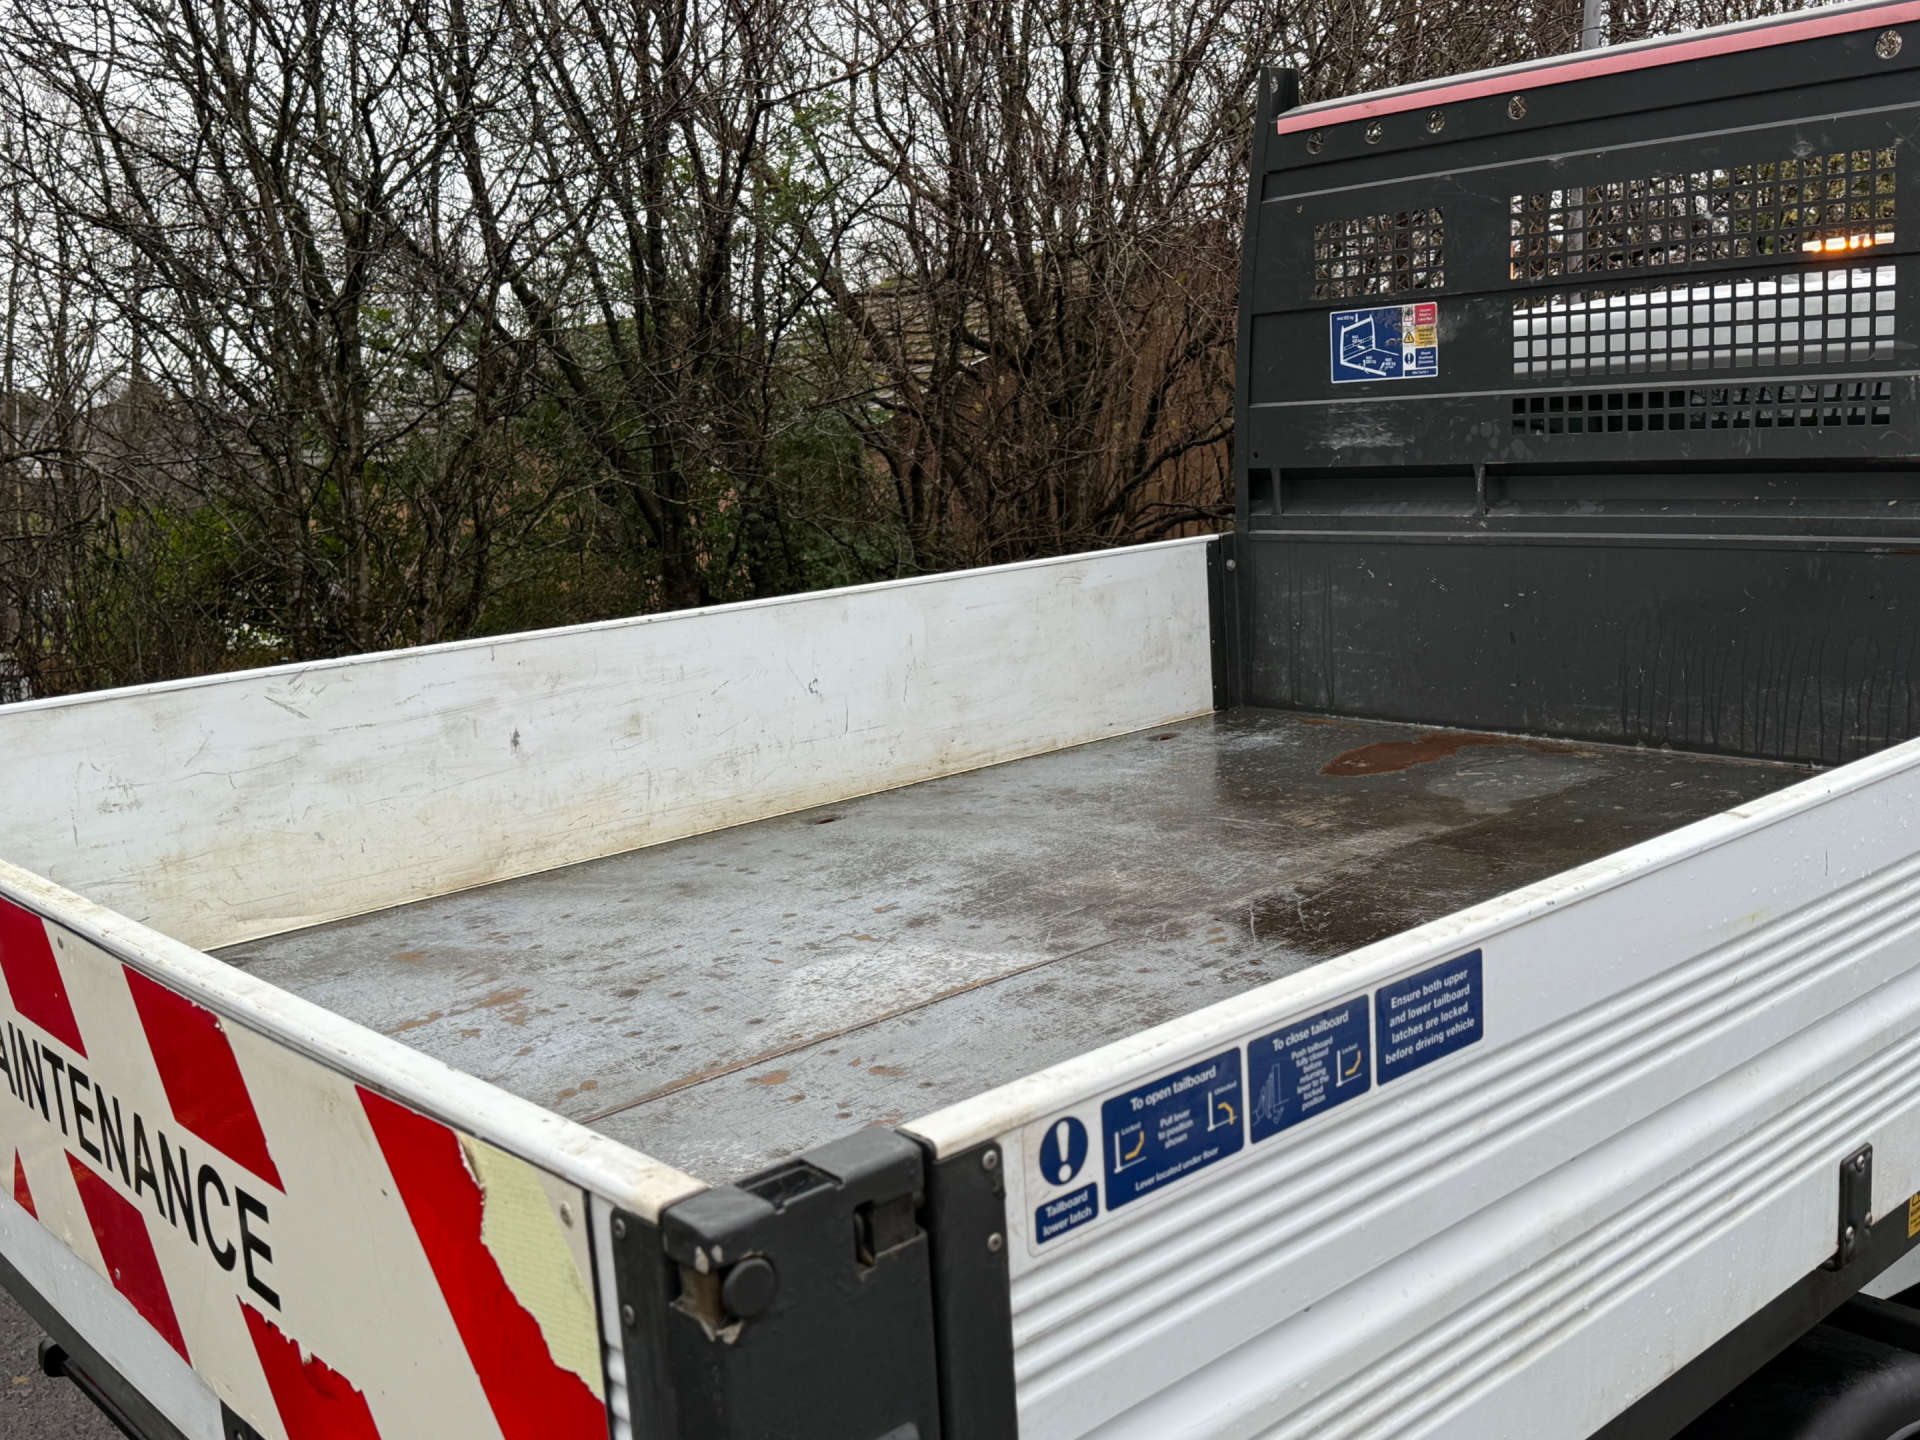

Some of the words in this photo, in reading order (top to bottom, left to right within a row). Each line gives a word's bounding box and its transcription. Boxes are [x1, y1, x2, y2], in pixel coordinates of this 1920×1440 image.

[1389, 1012, 1406, 1028] and
[1407, 1002, 1431, 1020] lower
[1433, 984, 1470, 1009] tailboard
[1391, 988, 1421, 1008] Ensure
[1422, 980, 1442, 996] both
[1444, 969, 1468, 987] upper
[1272, 1038, 1284, 1052] To
[1285, 1028, 1310, 1047] close
[1310, 1010, 1350, 1036] tailboard
[1385, 1044, 1414, 1065] before
[1414, 1030, 1444, 1051] driving
[1446, 1016, 1475, 1038] vehicle
[1392, 1022, 1424, 1044] latches
[1425, 1016, 1439, 1030] are
[1440, 1002, 1468, 1023] locked
[1307, 1035, 1334, 1054] tailboard
[1130, 1096, 1144, 1112] To
[1145, 1087, 1172, 1106] open
[1172, 1065, 1217, 1094] tailboard
[1158, 1131, 1166, 1142] to
[1166, 1119, 1194, 1138] position
[1159, 1116, 1173, 1129] Pull
[1174, 1110, 1191, 1123] lever
[1164, 1133, 1188, 1149] shown
[1135, 1174, 1156, 1192] Lever
[1156, 1163, 1182, 1182] located
[1182, 1154, 1202, 1170] under
[1203, 1147, 1219, 1160] floor
[1042, 1216, 1069, 1237] lower
[1070, 1206, 1092, 1227] latch
[1045, 1189, 1088, 1218] Tailboard
